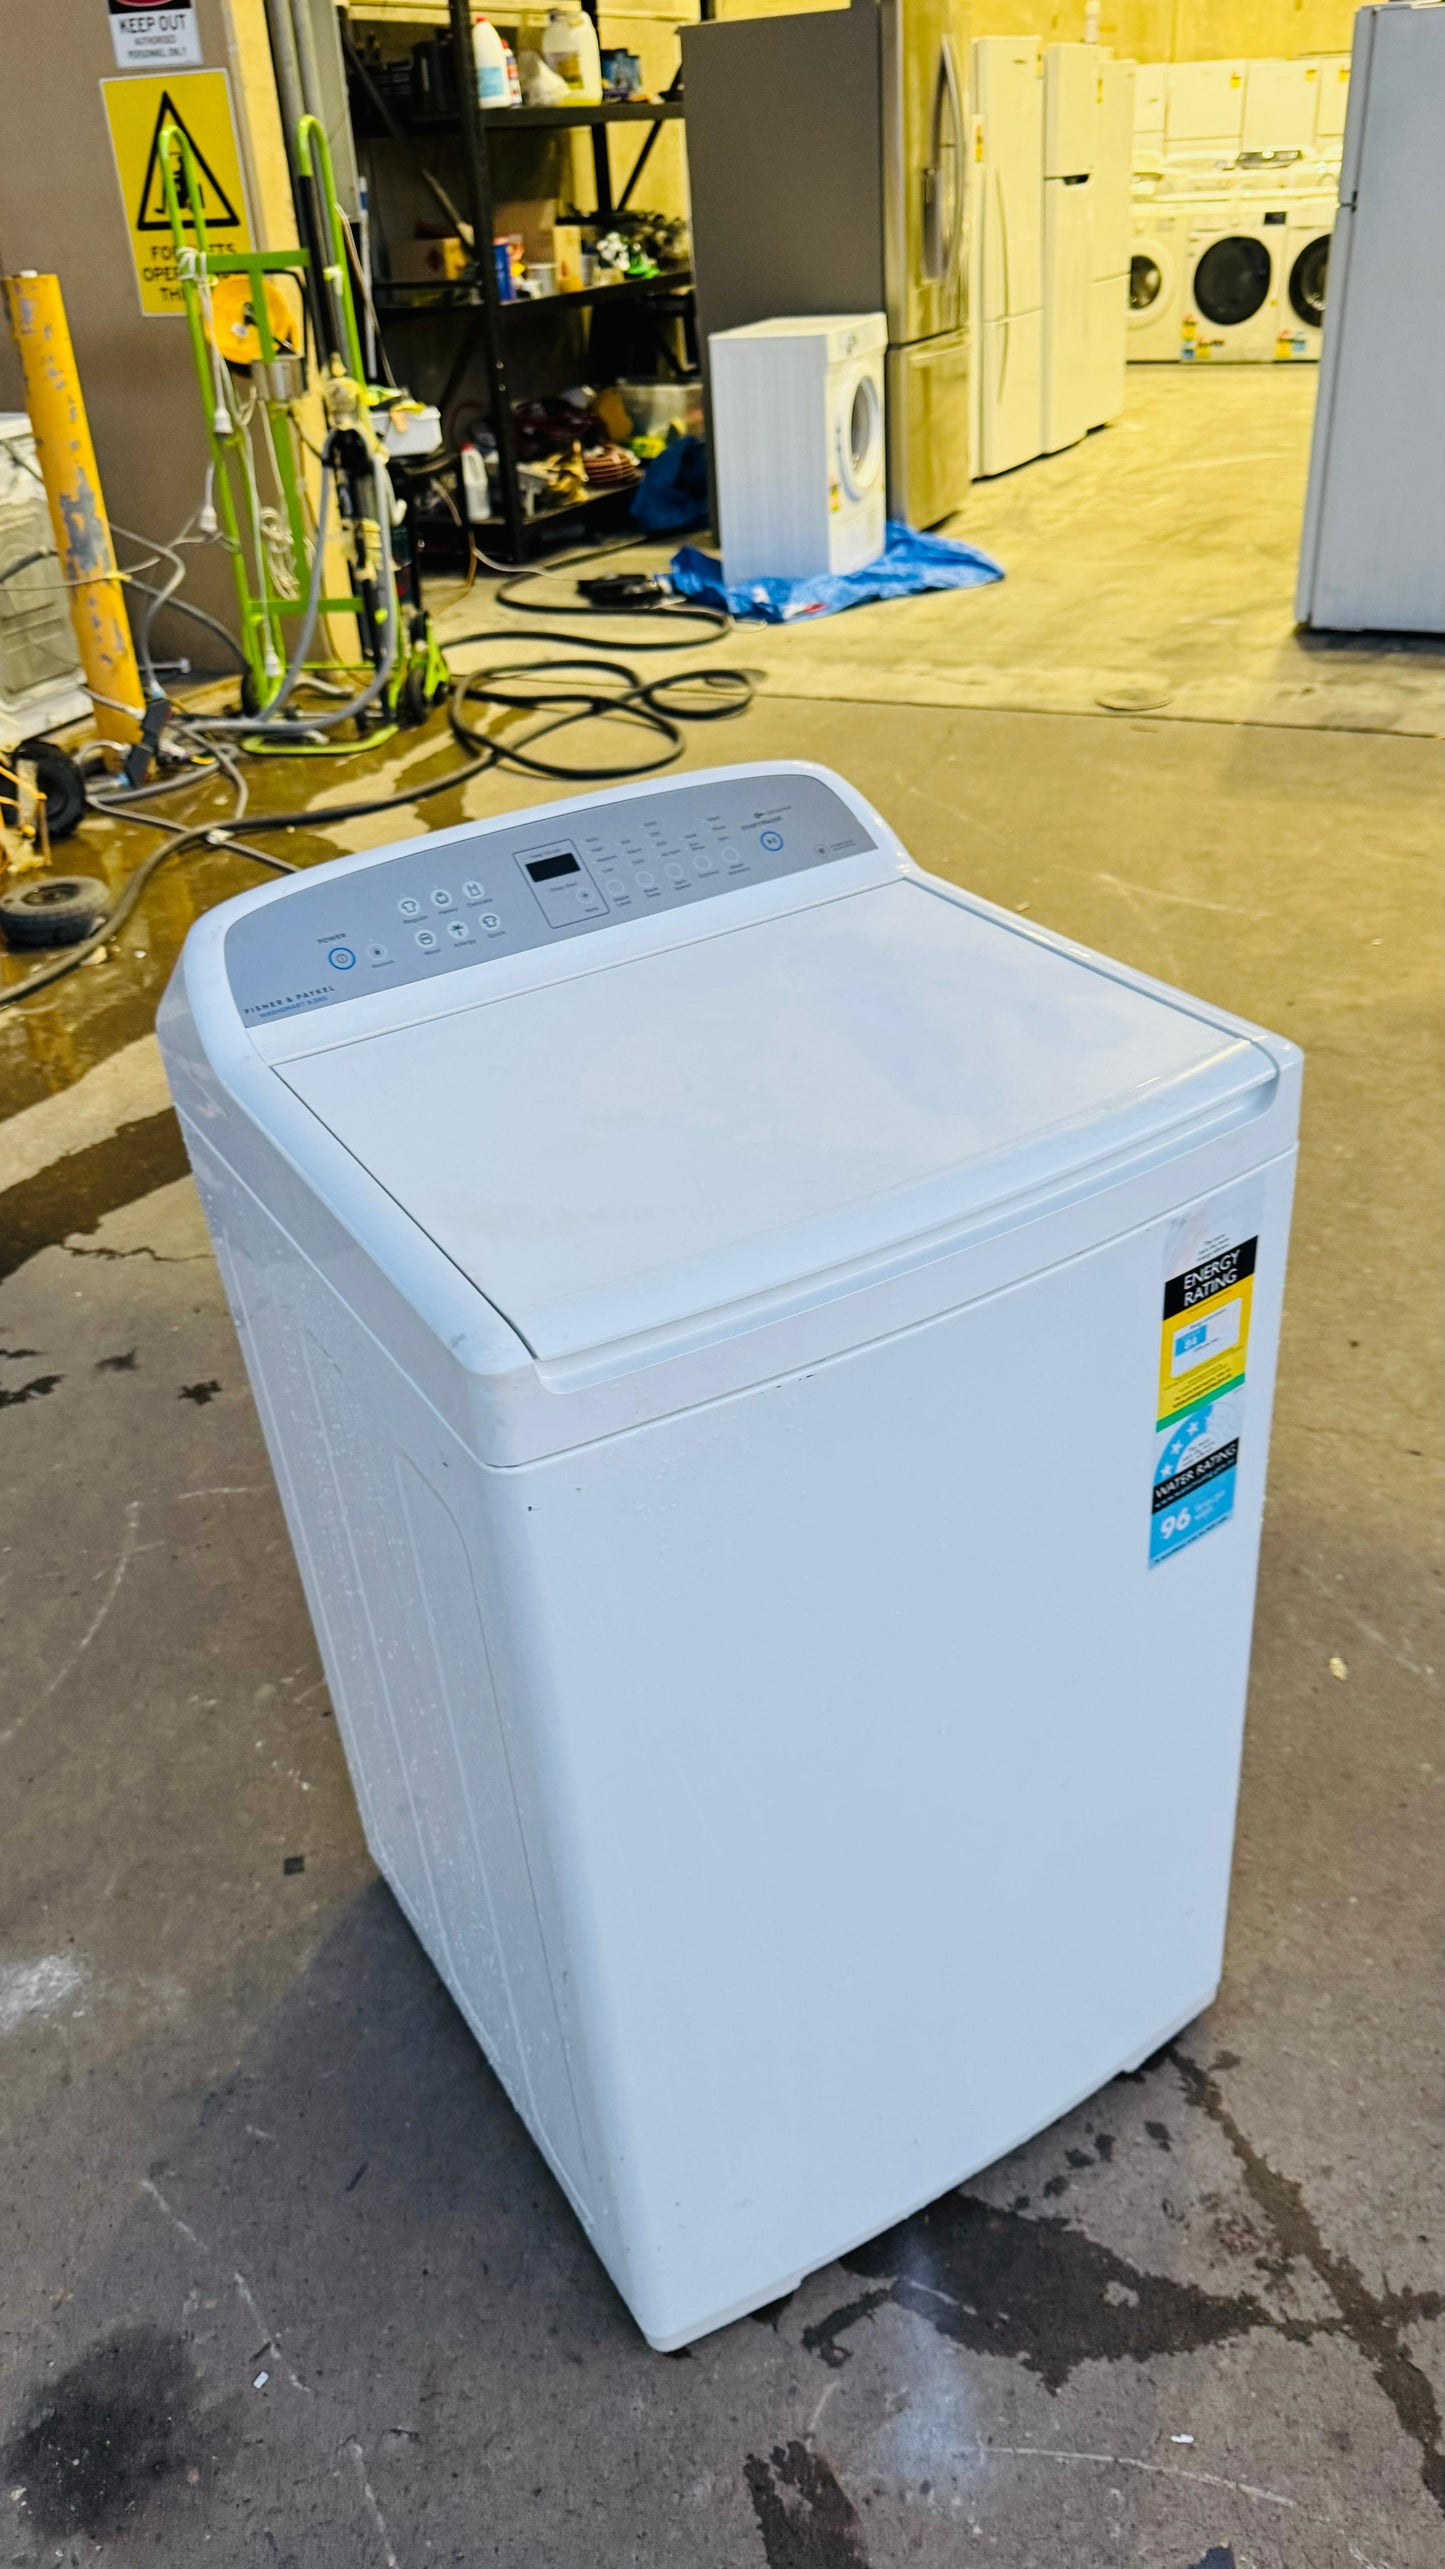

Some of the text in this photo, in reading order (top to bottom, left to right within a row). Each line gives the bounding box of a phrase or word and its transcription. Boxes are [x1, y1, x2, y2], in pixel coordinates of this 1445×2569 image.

[120, 13, 187, 34] KEEP OUT
[244, 999, 283, 1014] FISHER
[296, 986, 336, 999] PAYKEL
[1183, 1249, 1241, 1290] ENERGY
[1183, 1268, 1238, 1307] RATING
[1154, 1468, 1195, 1499] WATER
[1195, 1443, 1238, 1477] RATING
[1160, 1507, 1192, 1540] 96
